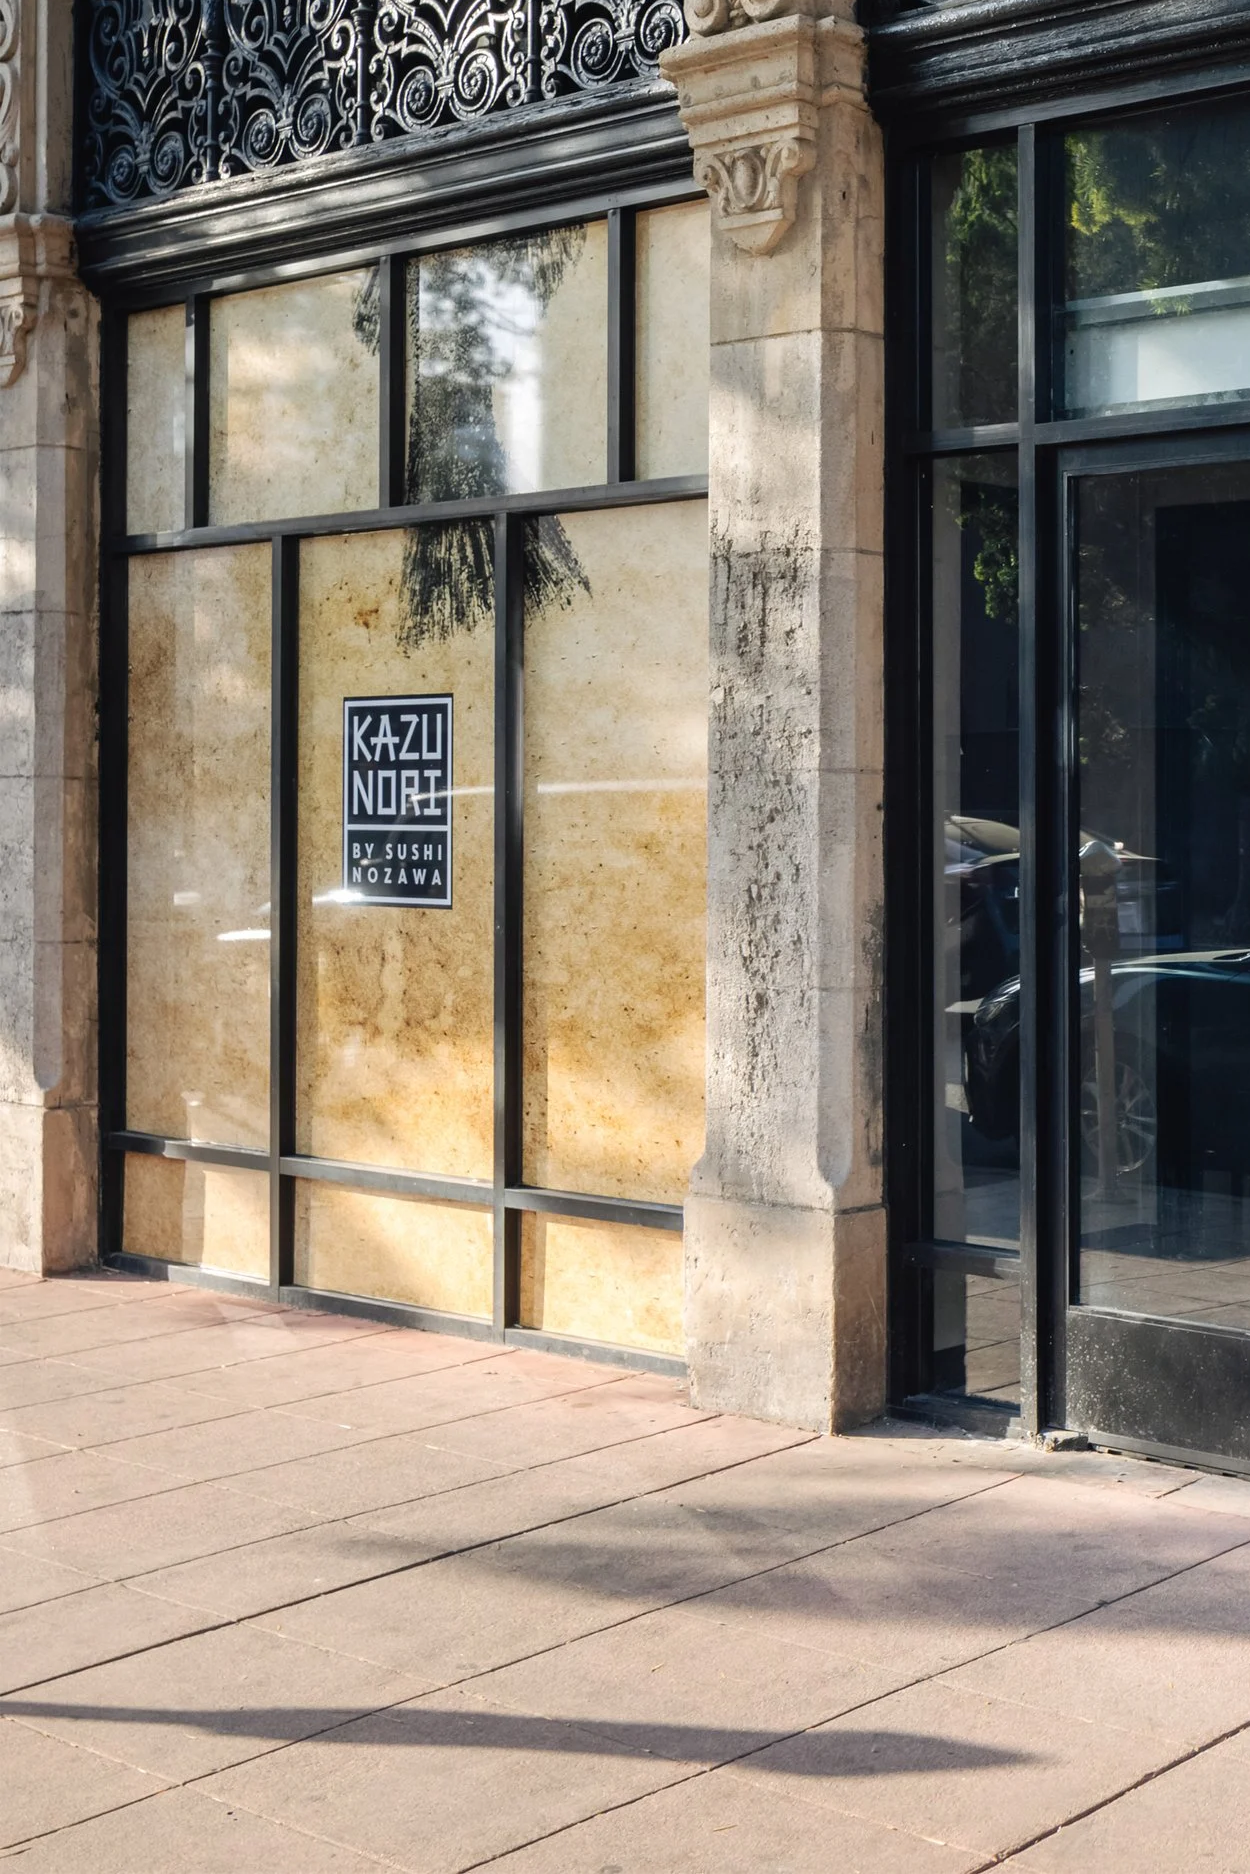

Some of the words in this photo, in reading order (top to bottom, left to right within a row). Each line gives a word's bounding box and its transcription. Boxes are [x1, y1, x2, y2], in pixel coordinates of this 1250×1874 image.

[352, 713, 443, 762] KAZU
[352, 769, 442, 816] NORI
[352, 842, 375, 859] BY
[385, 843, 443, 861] SUSHI
[352, 866, 442, 886] NOZAWA
